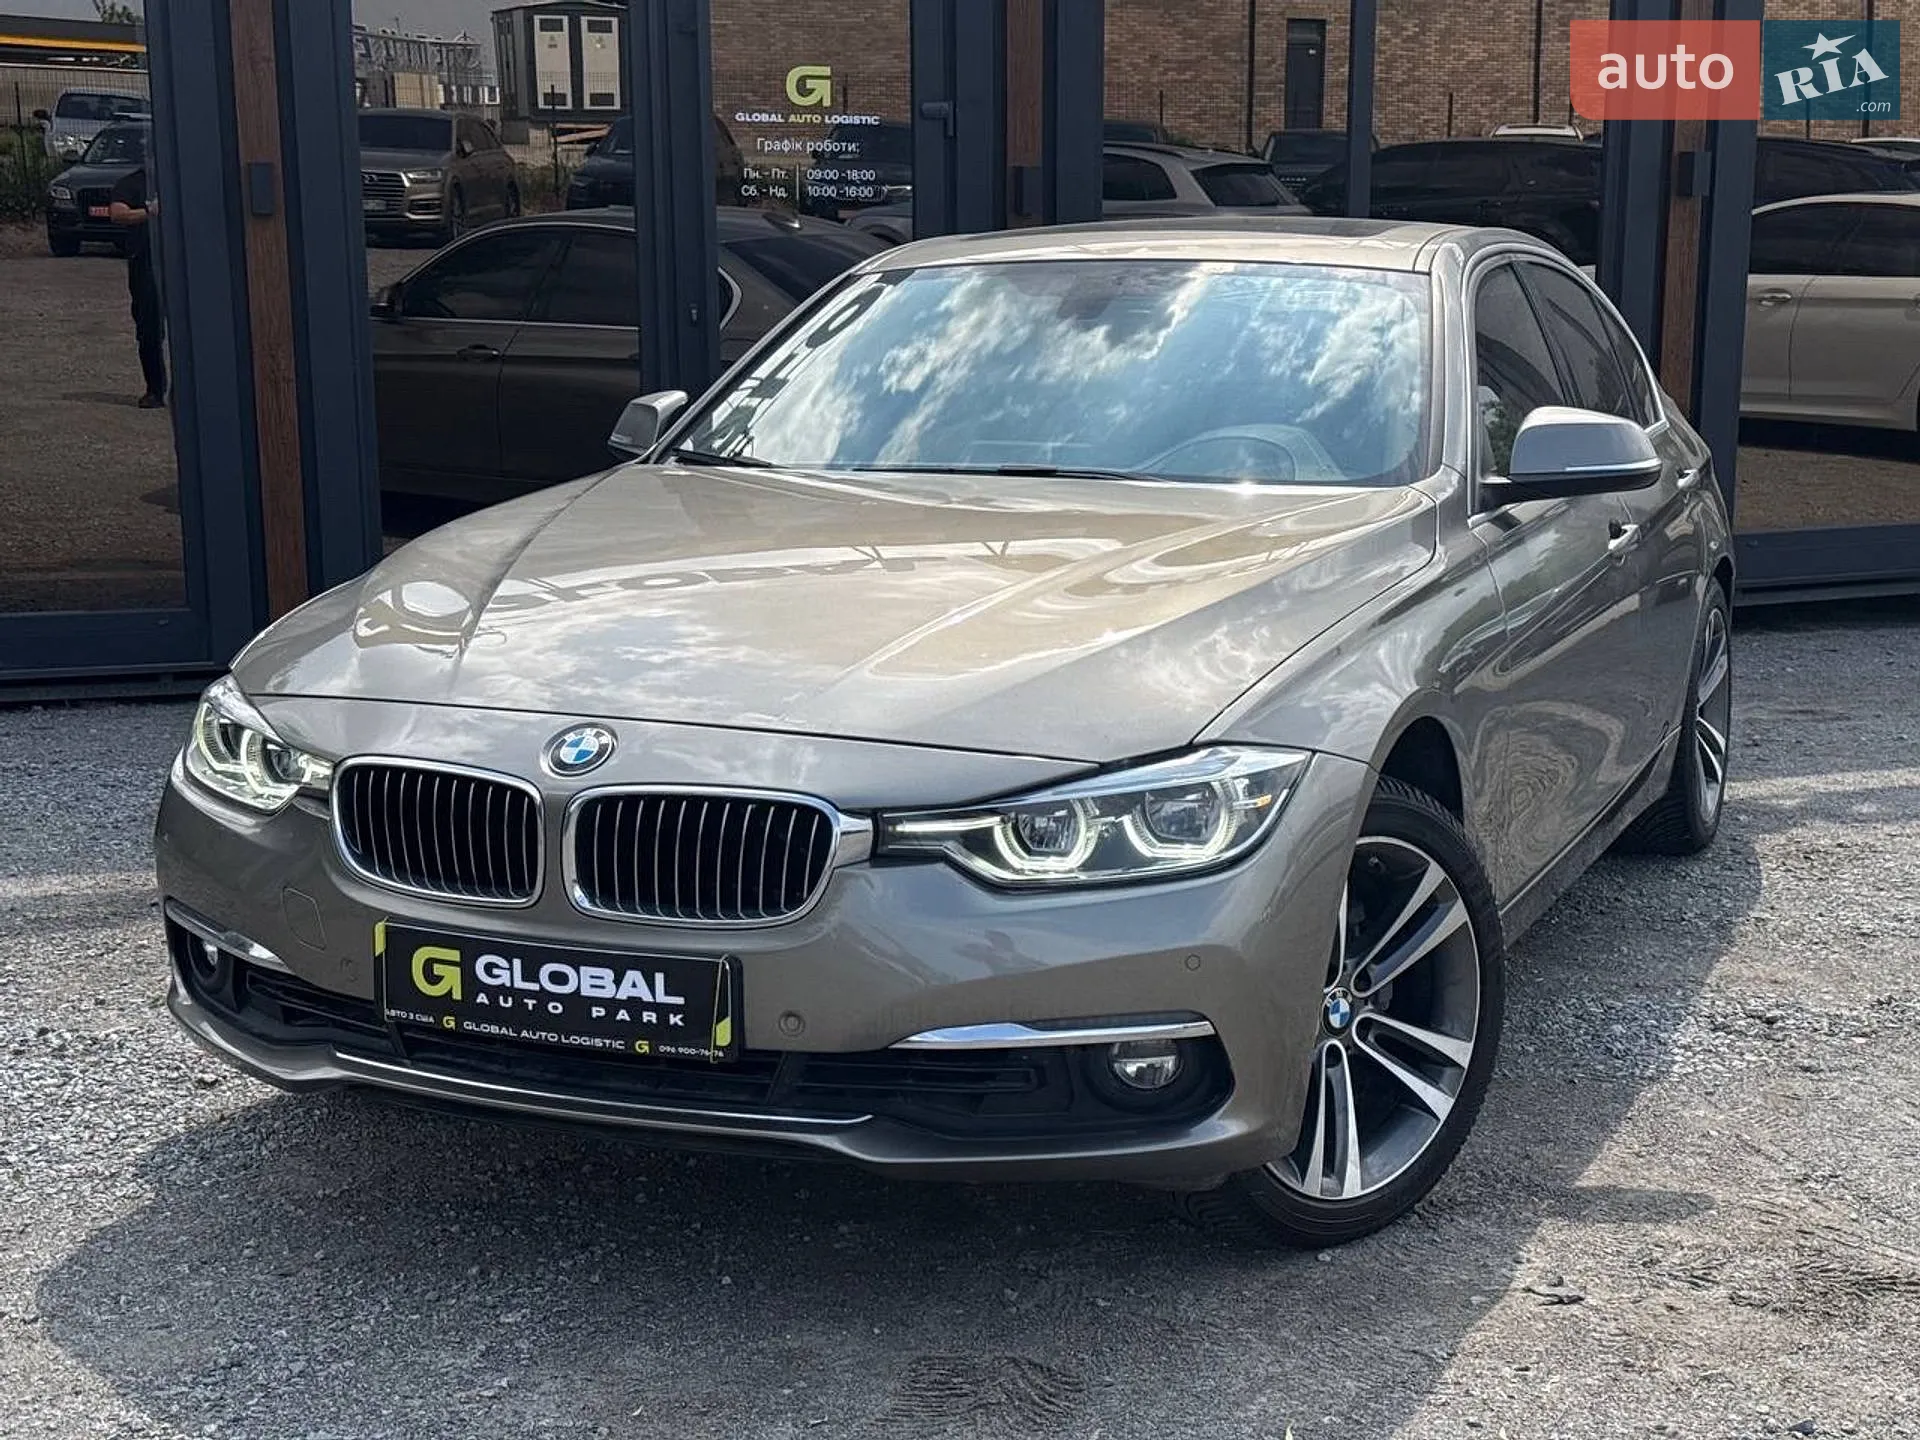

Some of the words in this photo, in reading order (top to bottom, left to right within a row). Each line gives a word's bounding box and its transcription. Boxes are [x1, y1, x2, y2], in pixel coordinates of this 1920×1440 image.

[734, 112, 785, 123] GLOBAL
[788, 114, 822, 124] AUTO
[824, 115, 881, 126] LOGISTIC
[756, 137, 803, 154] Графік
[806, 140, 860, 155] роботи:
[806, 169, 840, 180] 09:00
[808, 185, 837, 196] 10:00
[475, 954, 685, 1005] GLOBAL
[476, 992, 563, 1014] AUTO
[591, 1006, 685, 1027] PARK
[463, 1021, 518, 1037] GLOBAL
[520, 1029, 558, 1042] AUTO
[561, 1034, 626, 1050] LOGISTIC
